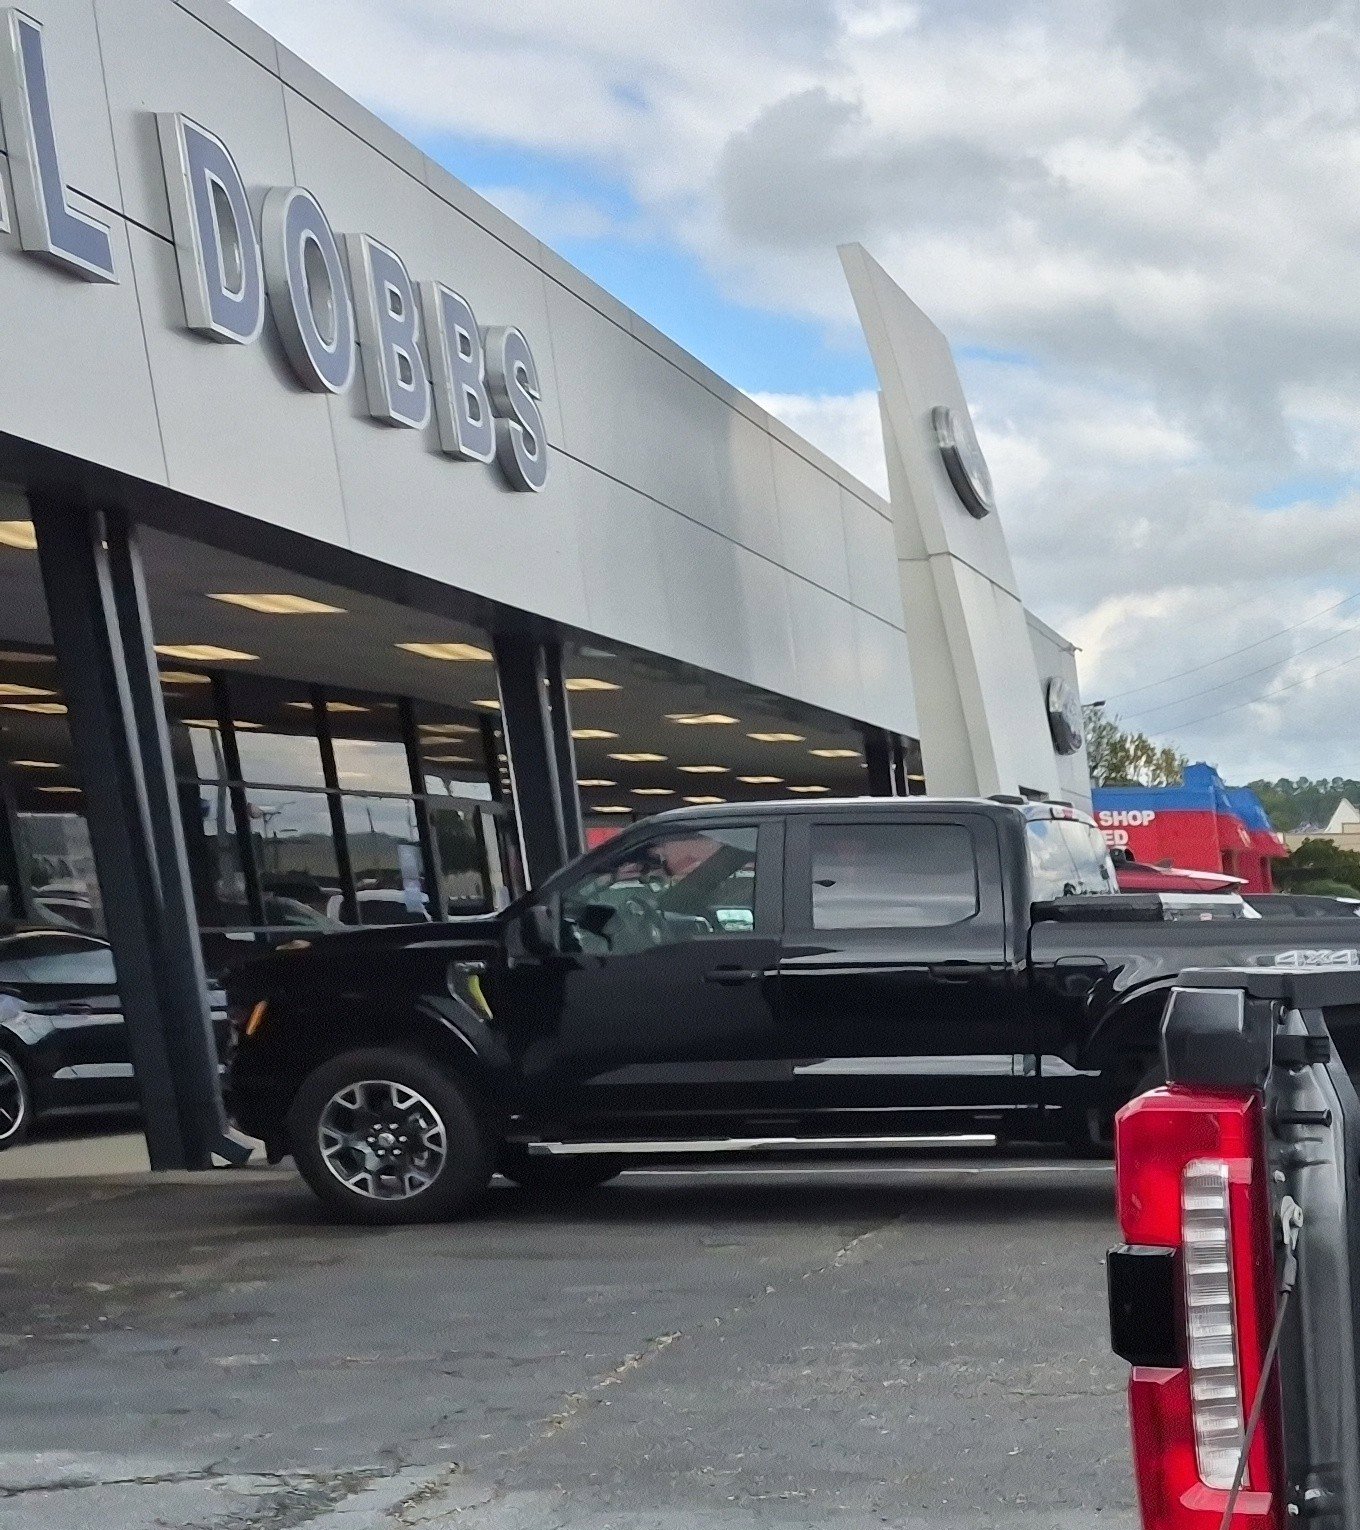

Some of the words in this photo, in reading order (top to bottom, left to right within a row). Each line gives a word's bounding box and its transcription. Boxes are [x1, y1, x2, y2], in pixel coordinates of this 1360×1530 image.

[0, 9, 118, 284] L
[157, 112, 547, 492] DOBBS
[1099, 811, 1155, 826] SHOP
[1101, 830, 1128, 845] ED
